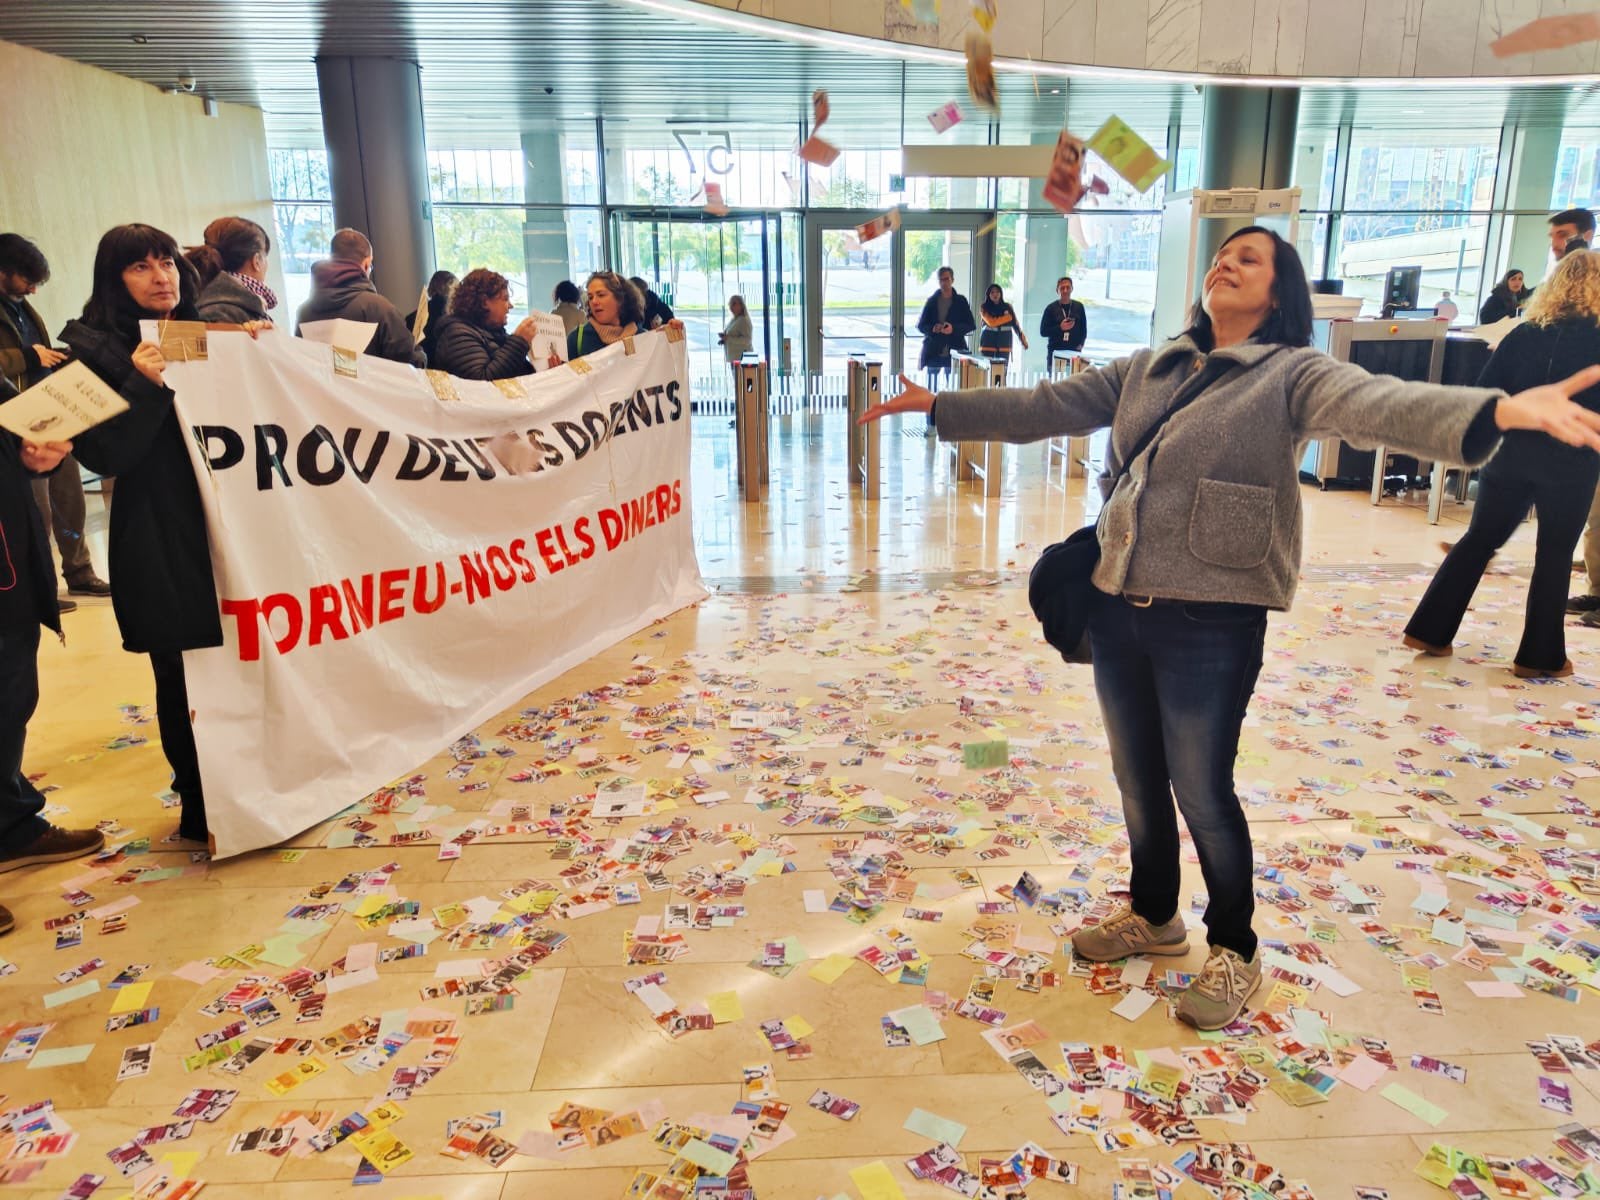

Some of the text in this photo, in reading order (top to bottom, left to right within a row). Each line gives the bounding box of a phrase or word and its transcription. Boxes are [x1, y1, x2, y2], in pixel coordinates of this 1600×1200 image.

[395, 429, 564, 481] DEUS
[221, 479, 681, 662] TORNEU-NOS ELS DINERS
